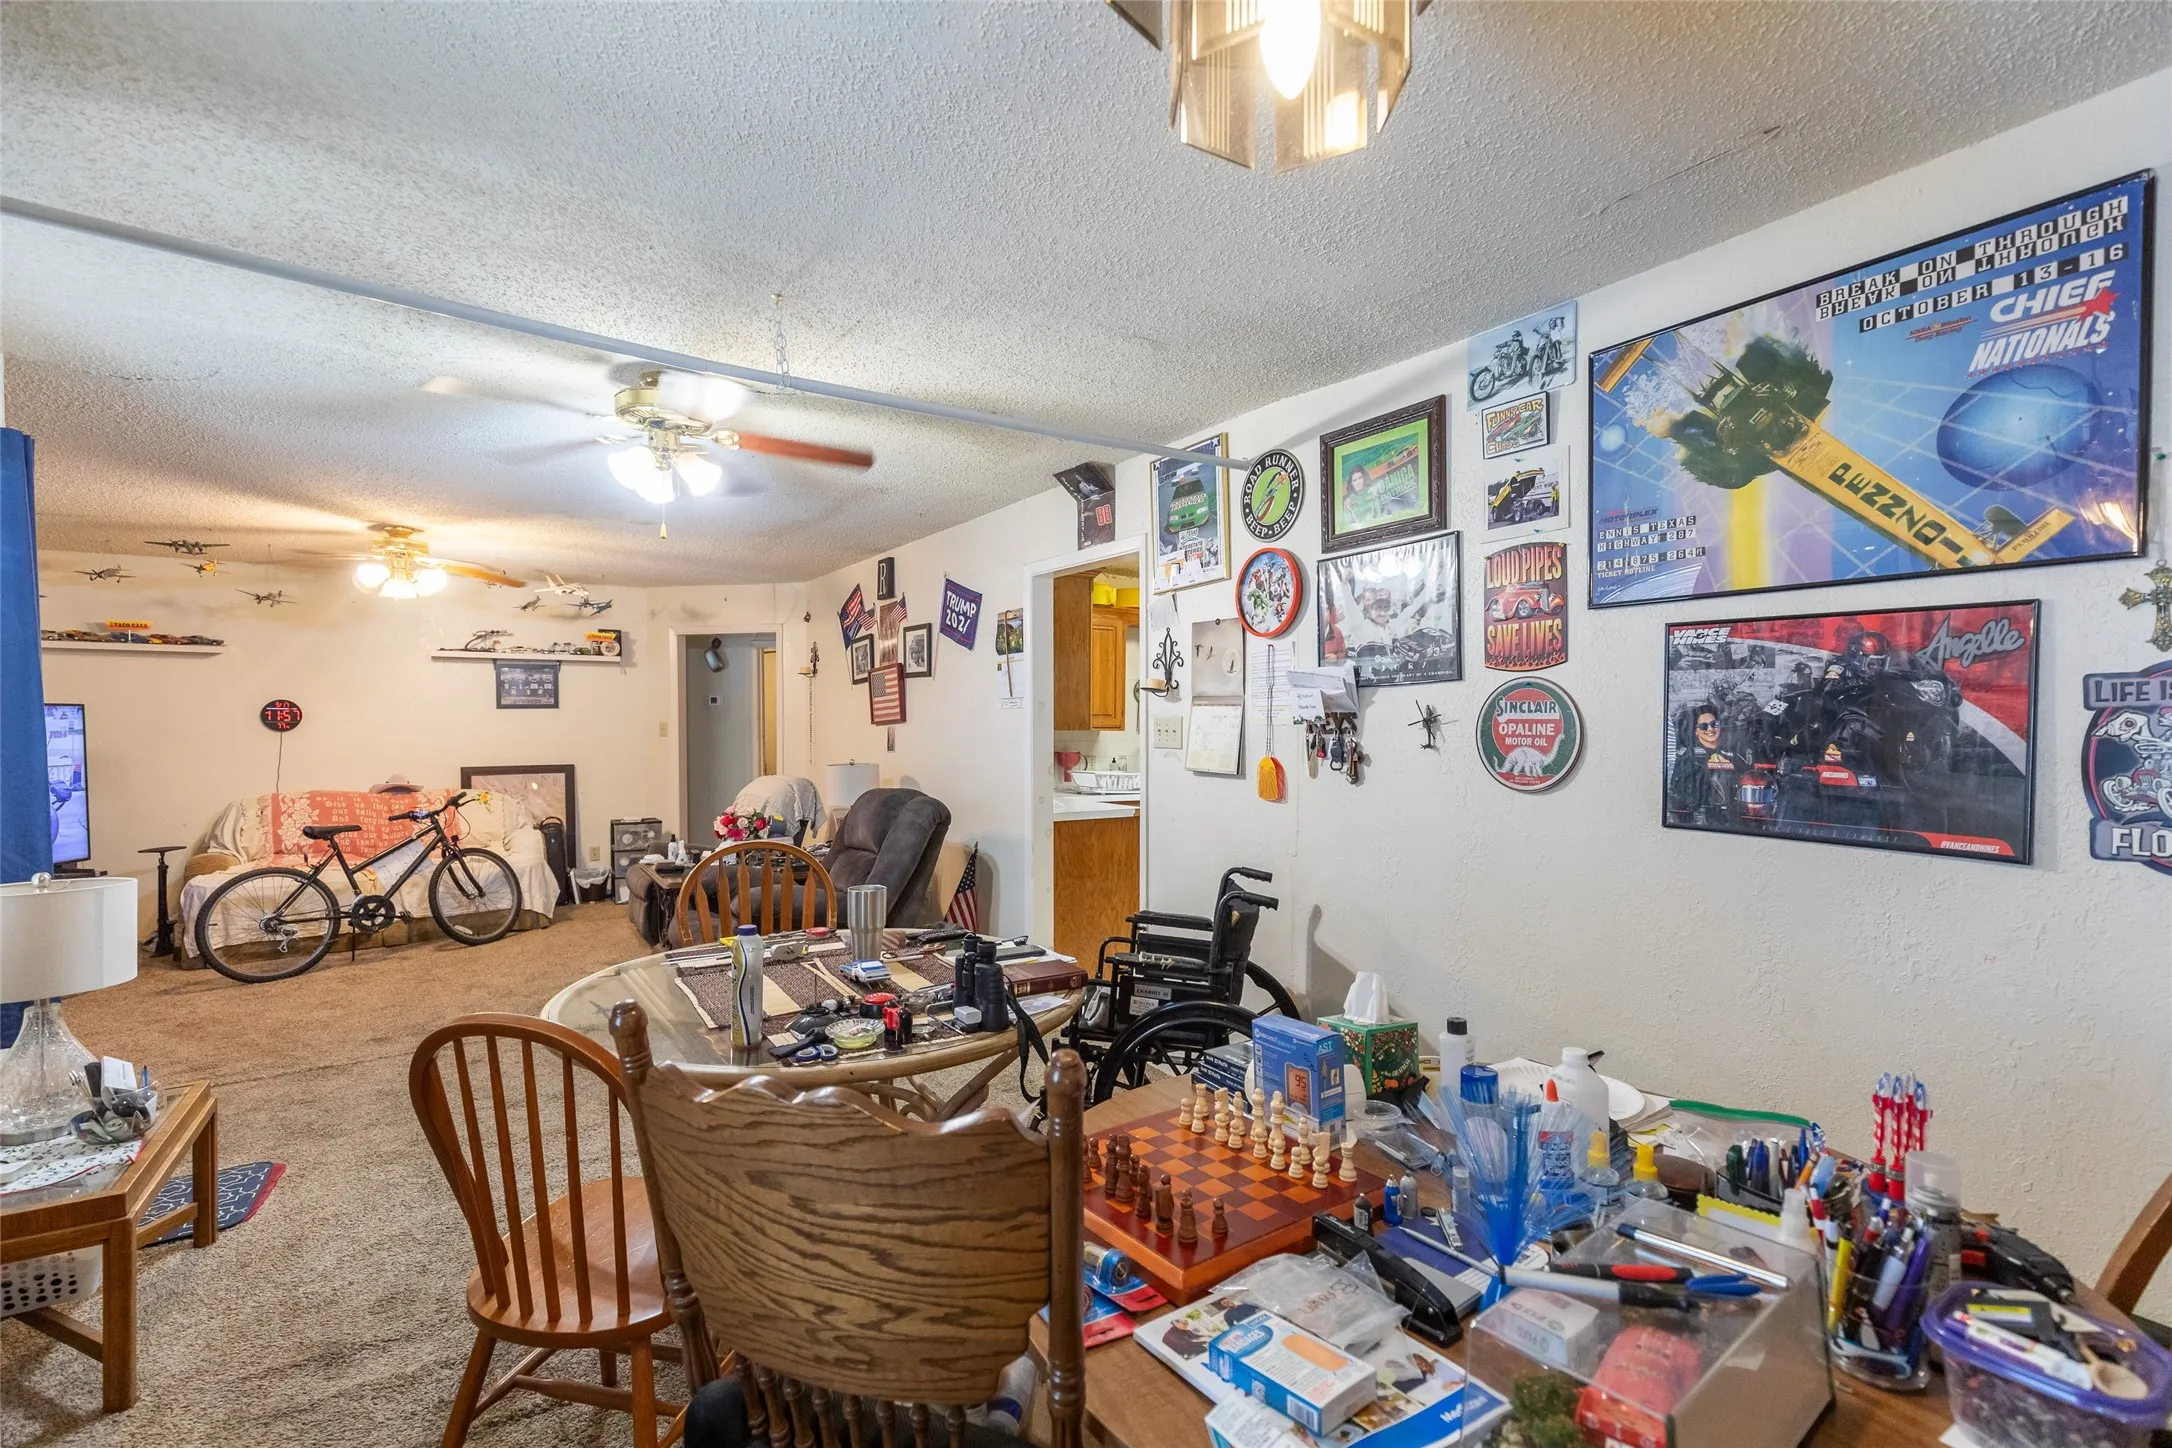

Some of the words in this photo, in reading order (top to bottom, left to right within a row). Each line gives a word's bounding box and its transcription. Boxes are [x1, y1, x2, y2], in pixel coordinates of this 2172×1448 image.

[1820, 271, 1897, 305] BREAK
[1921, 255, 1952, 273] ON
[1978, 201, 2124, 254] THROUGH
[1862, 285, 1991, 332] OCTOBER
[2018, 245, 2125, 287] 13-16
[1989, 270, 2116, 322] CHIEF
[1969, 311, 2116, 373] NATIONALS
[1486, 406, 1517, 432] FUNNY
[1518, 398, 1544, 412] CAR
[1244, 464, 1261, 504] ROAD
[1265, 454, 1298, 490] RUNNER
[1246, 515, 1268, 537] BEEP
[1274, 502, 1295, 534] BEEP
[1600, 526, 1639, 539] ENNIS
[1650, 516, 1695, 531] TEXAS
[1599, 535, 1656, 551] HIGHWAY
[1669, 529, 1694, 540] 287
[1486, 548, 1521, 590] LOUD
[1523, 544, 1563, 583] PIPES
[946, 590, 977, 618] TRUMP
[1487, 622, 1521, 657] SAVE
[1523, 618, 1563, 656] LIVES
[1672, 635, 1727, 645] HINES
[1674, 627, 1731, 638] VANCE
[2094, 680, 2151, 702] LIFE
[1496, 696, 1558, 718] SINCLAIR
[1499, 722, 1555, 736] OPALINE
[1505, 737, 1533, 746] MOTOR
[1535, 737, 1548, 746] OIL
